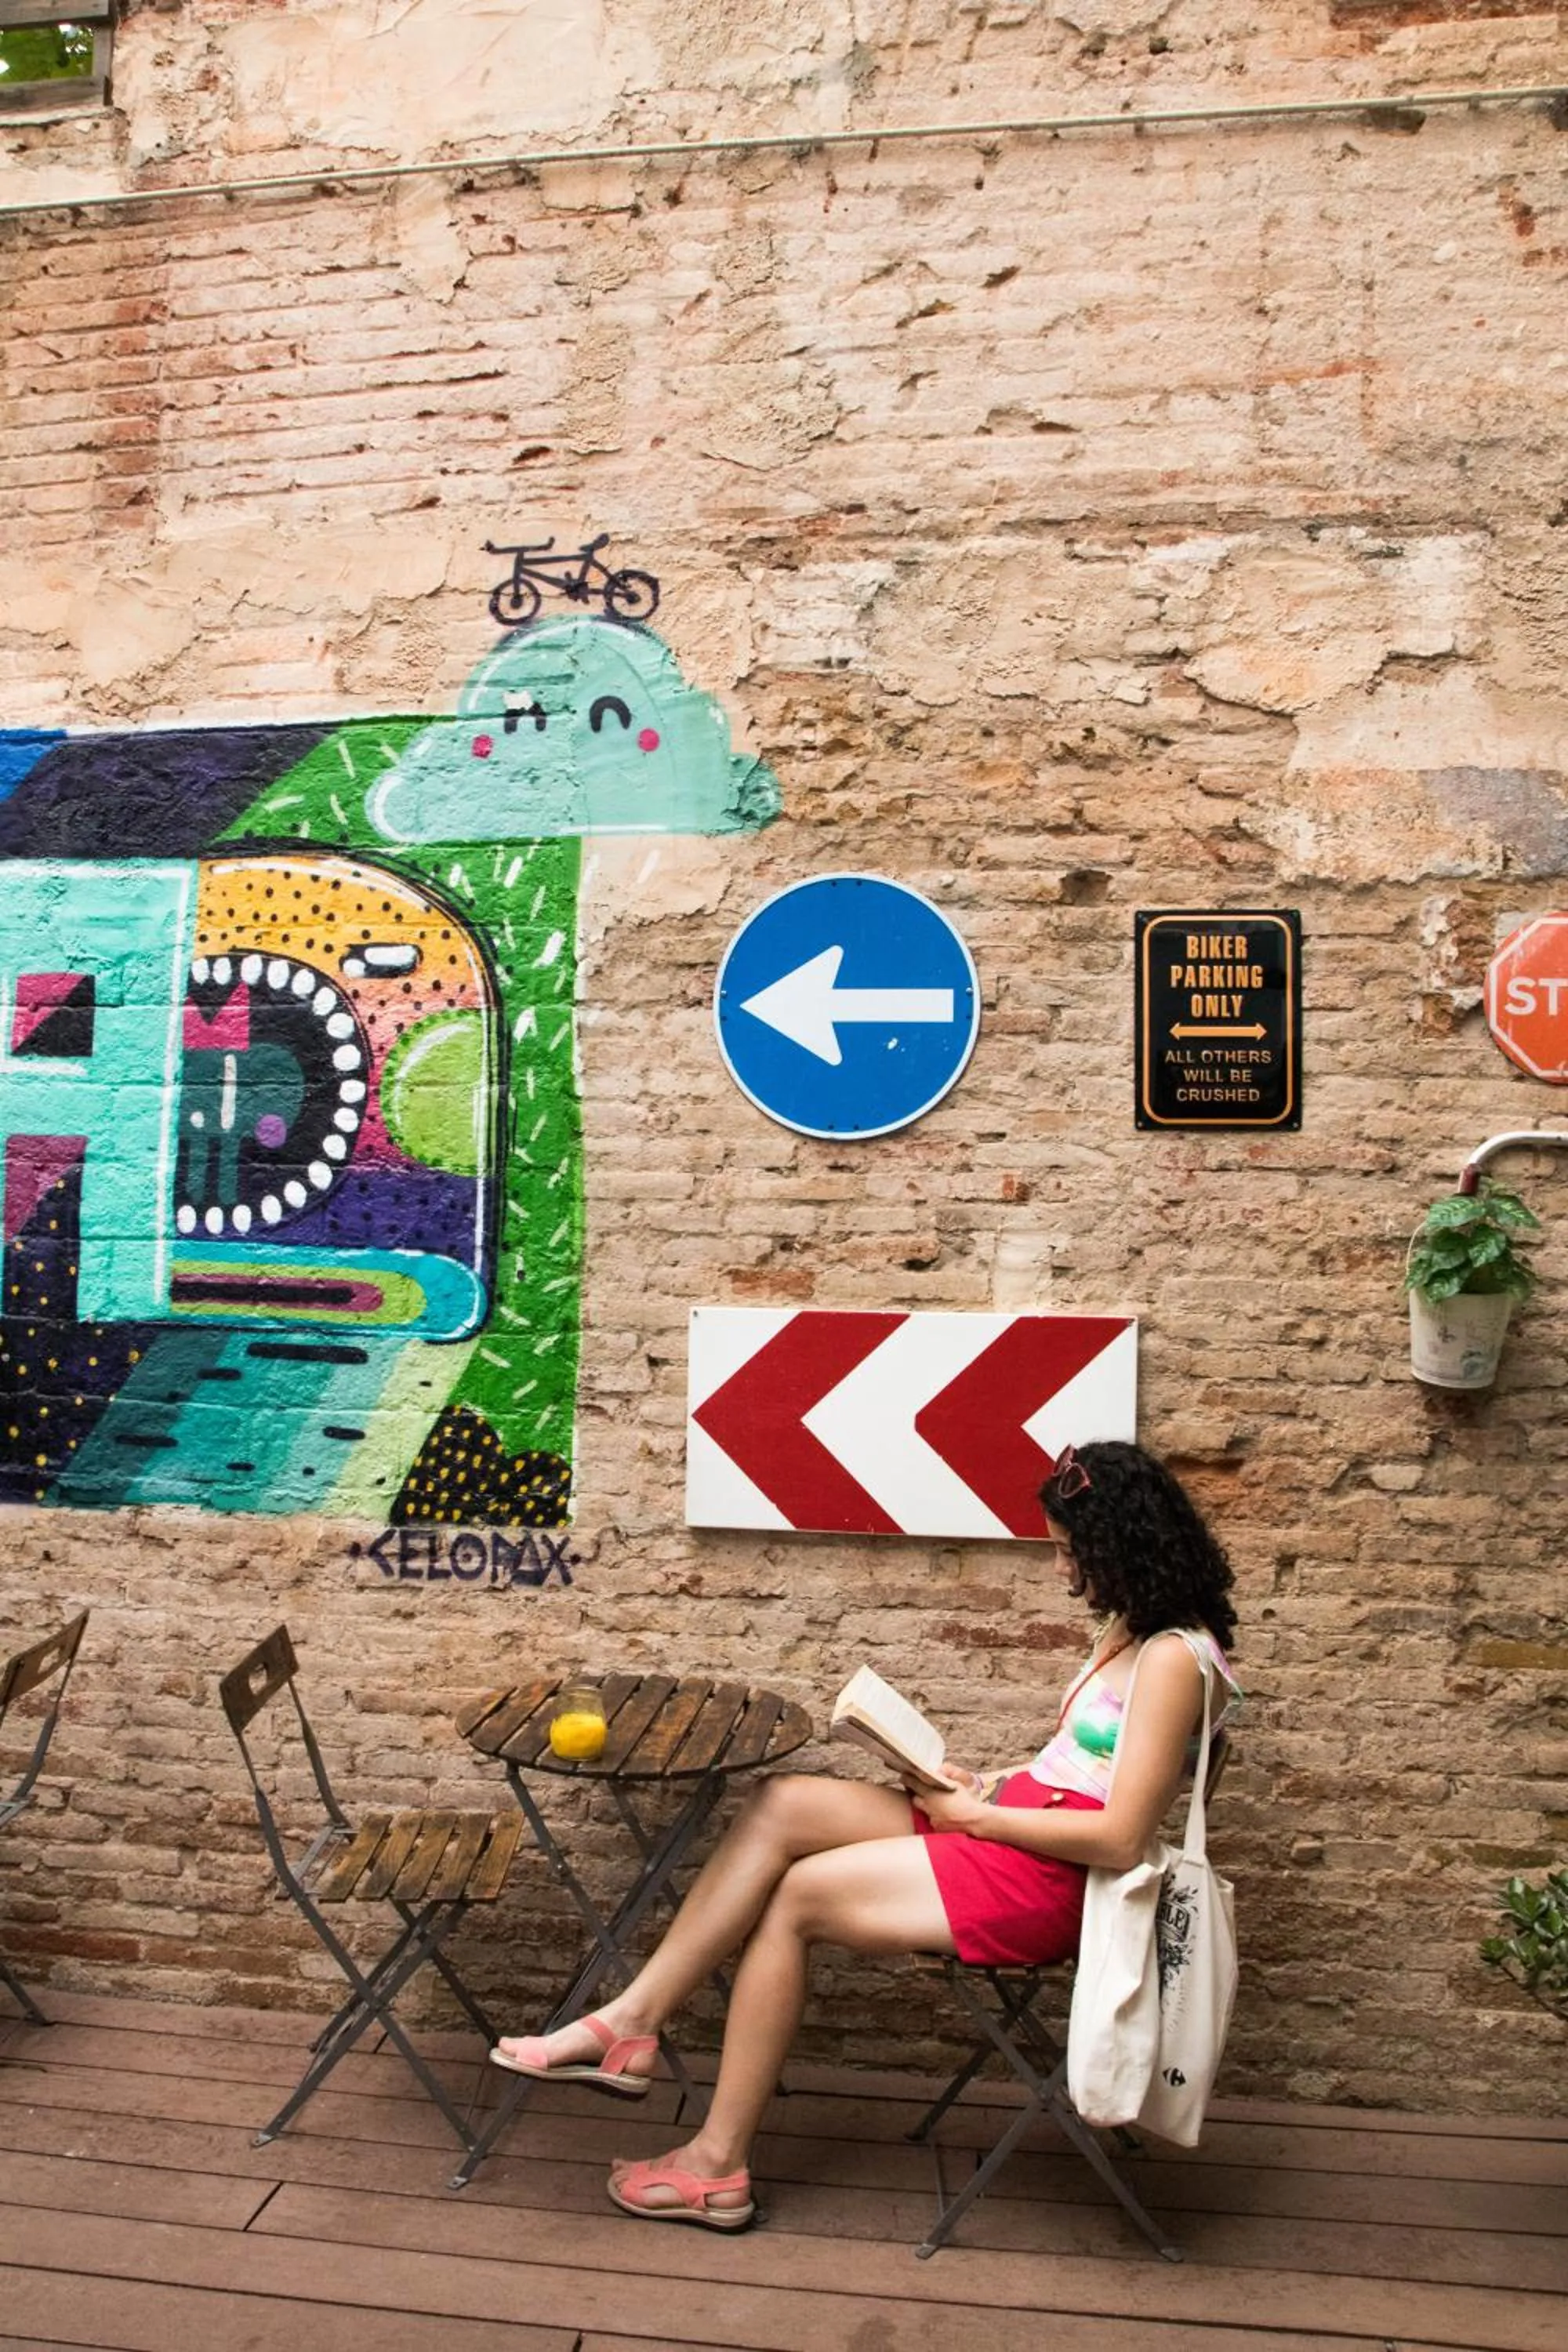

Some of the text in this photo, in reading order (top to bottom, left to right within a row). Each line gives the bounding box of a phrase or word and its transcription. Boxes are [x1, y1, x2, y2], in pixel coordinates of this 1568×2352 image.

[1186, 935, 1248, 959] BIKER
[1170, 965, 1264, 989] PARKING
[1190, 994, 1243, 1018] ONLY
[1164, 1050, 1272, 1064] ALL OTHERS
[1183, 1069, 1252, 1083] WILL BE
[1177, 1088, 1261, 1102] CRUSHED
